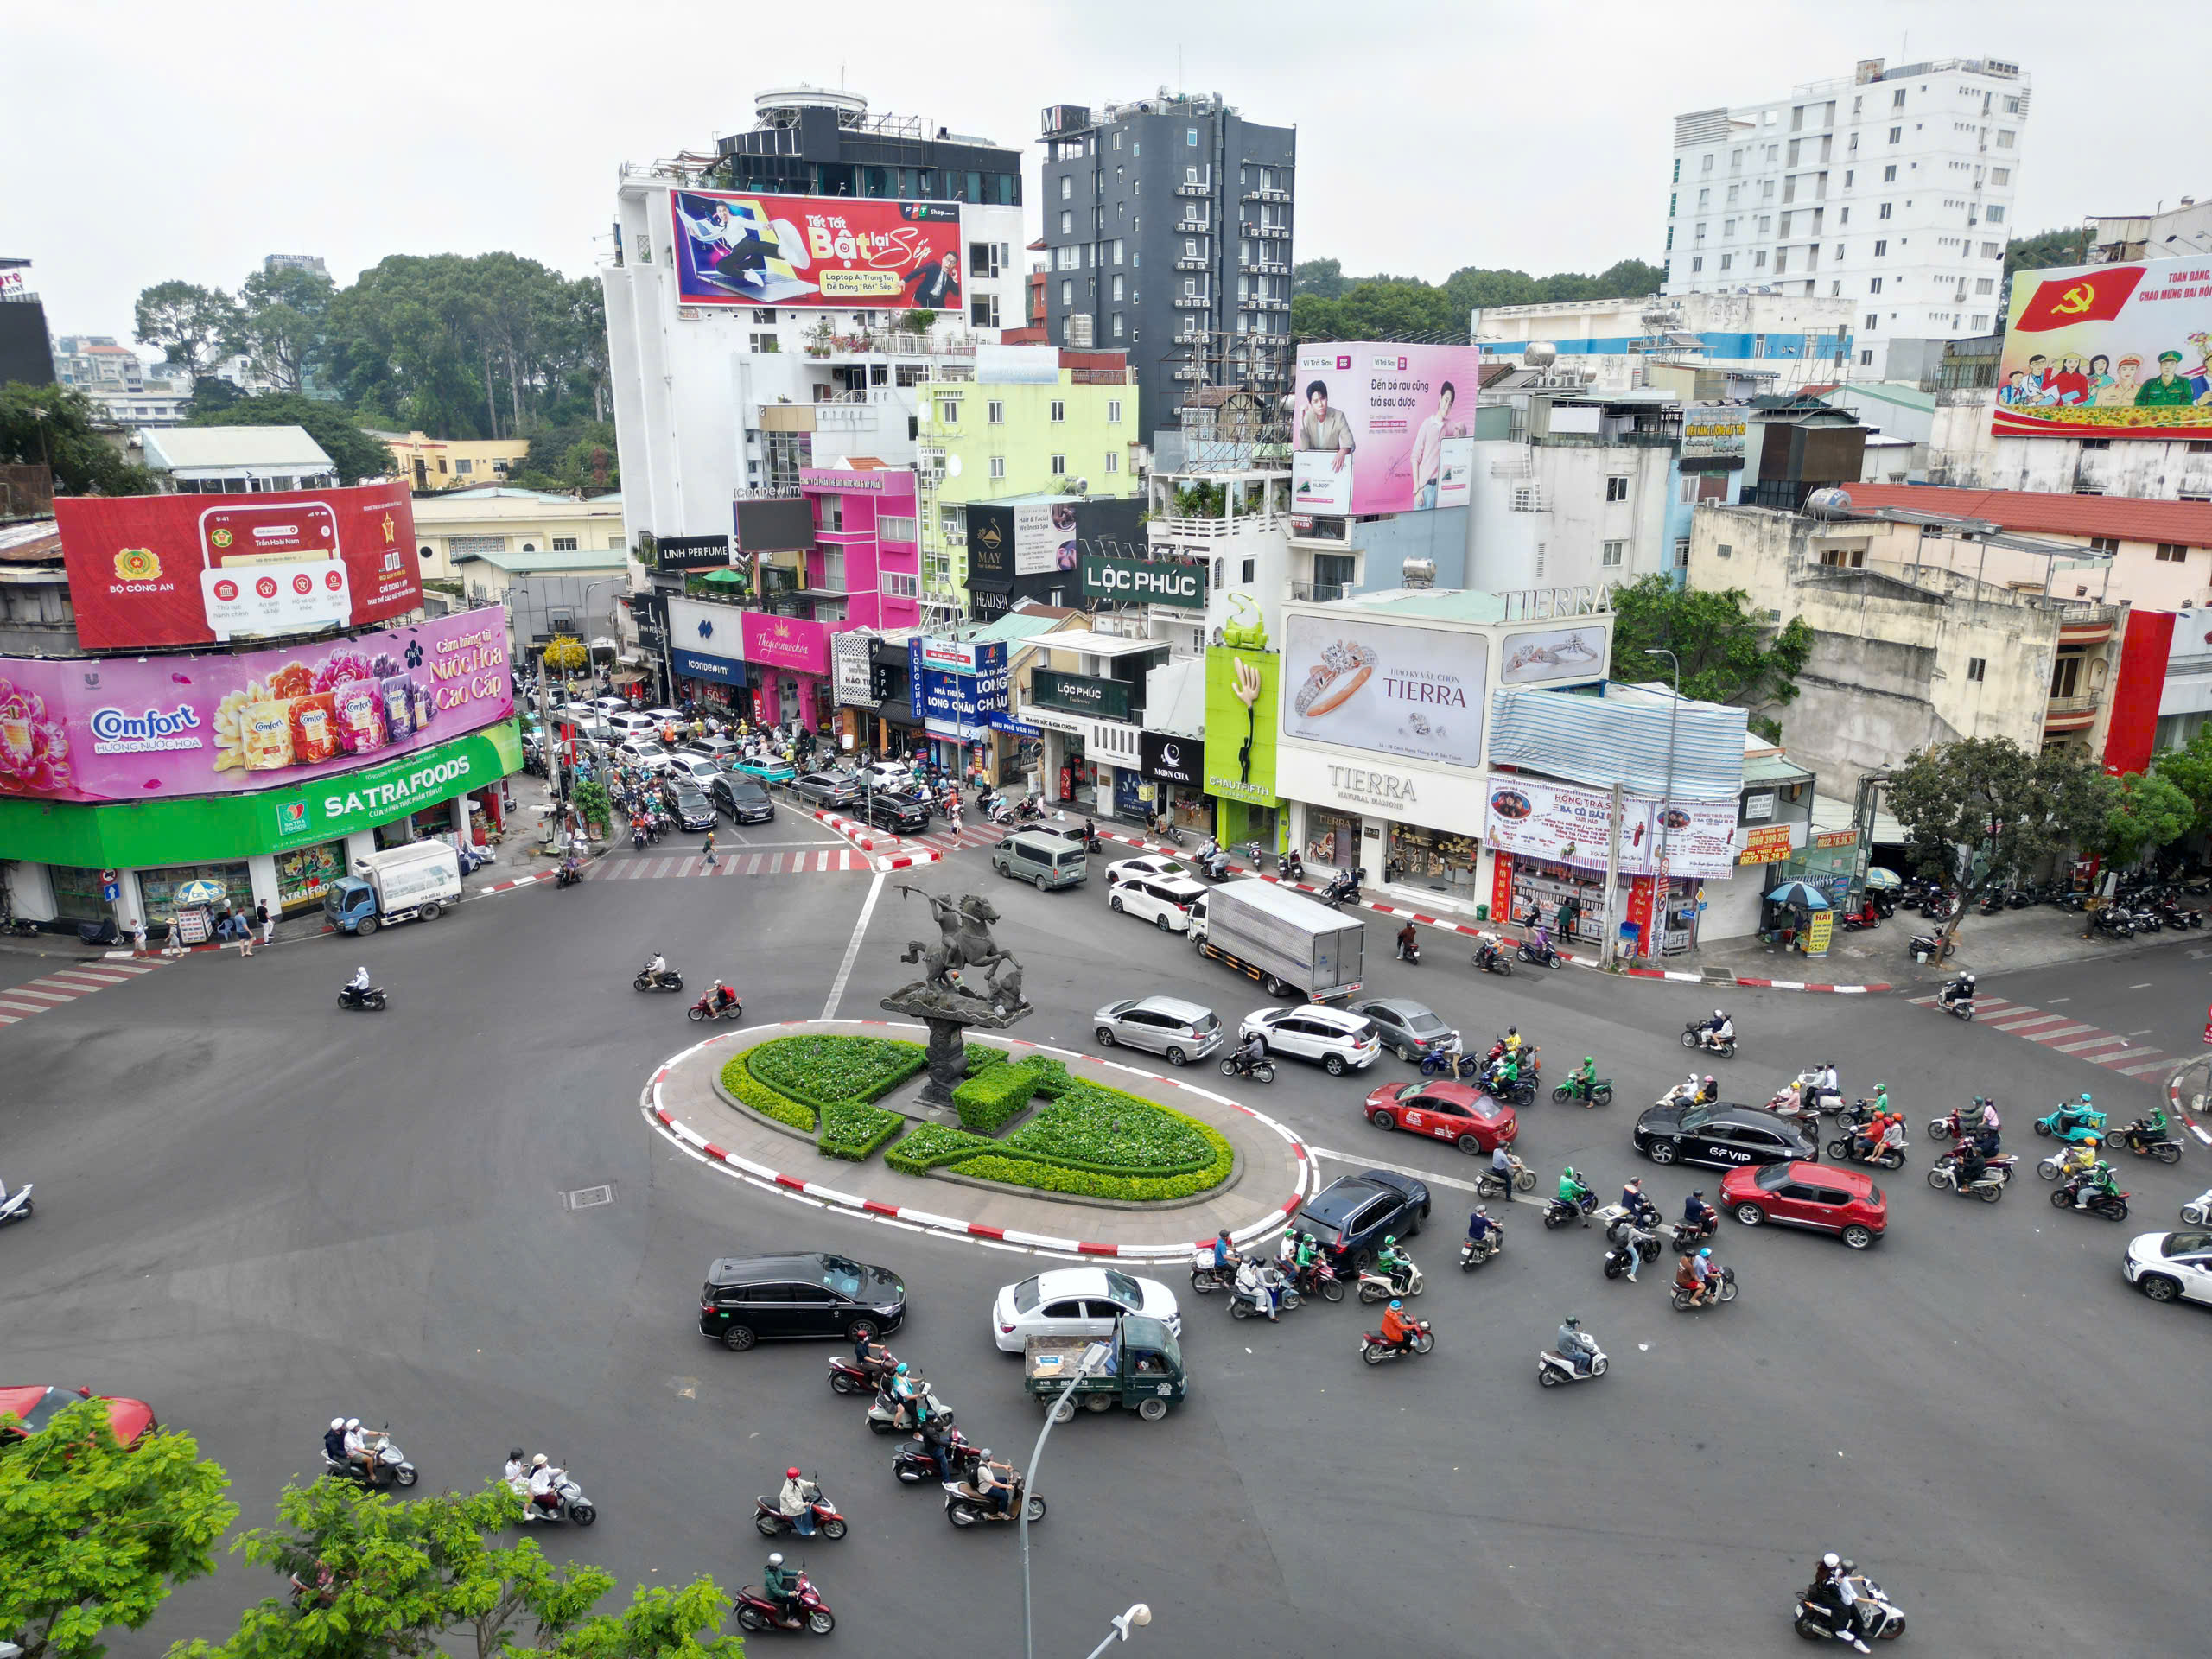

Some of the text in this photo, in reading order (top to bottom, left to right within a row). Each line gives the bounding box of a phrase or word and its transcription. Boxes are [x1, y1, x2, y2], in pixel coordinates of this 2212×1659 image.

[906, 206, 927, 217] FPT
[806, 215, 846, 229] Tết Tất
[807, 228, 872, 268] Bật
[871, 232, 889, 251] lại
[1371, 378, 1386, 391] Đến
[1412, 380, 1429, 393] cũng
[1370, 397, 1416, 410] trả sau được
[664, 546, 728, 559] LINH PERFUME
[978, 551, 1001, 564] MAY
[1088, 563, 1196, 596] LỘC PHÚC
[110, 583, 174, 594] BỘ CÔNG AN
[976, 591, 1009, 610] HEAD SPA
[1498, 583, 1611, 622] TIERRA
[639, 624, 649, 632] LINH
[429, 647, 503, 683] Nước Hoa
[976, 669, 988, 679] NHÀ
[436, 671, 502, 709] Cao Cấp
[934, 686, 946, 696] NHÀ
[976, 677, 1008, 694] LONG
[1057, 682, 1102, 699] LỘC PHÚC
[389, 691, 406, 705] Comfort
[1382, 677, 1466, 709] TIERRA
[346, 699, 372, 713] Comfort
[927, 696, 975, 714] LONG CHÂU
[92, 706, 198, 740] Comfort
[300, 711, 327, 725] Comfort
[255, 719, 283, 732] Comfort
[991, 721, 1003, 729] KHU
[1015, 724, 1027, 734] VĂN
[97, 738, 200, 753] HƯƠNG NƯỚC HOA
[1154, 767, 1189, 781] MOON CHA
[325, 755, 470, 817] SATRAFOODS
[1327, 765, 1417, 802] TIERRA
[1338, 791, 1404, 810] NATURAL DIAMOND
[369, 807, 384, 817] CỬA
[1560, 804, 1572, 815] BA
[285, 818, 307, 828] SATRA
[285, 823, 307, 833] FOODS
[1320, 814, 1351, 829] TIERRA
[1709, 1147, 1751, 1161] GF VIP
